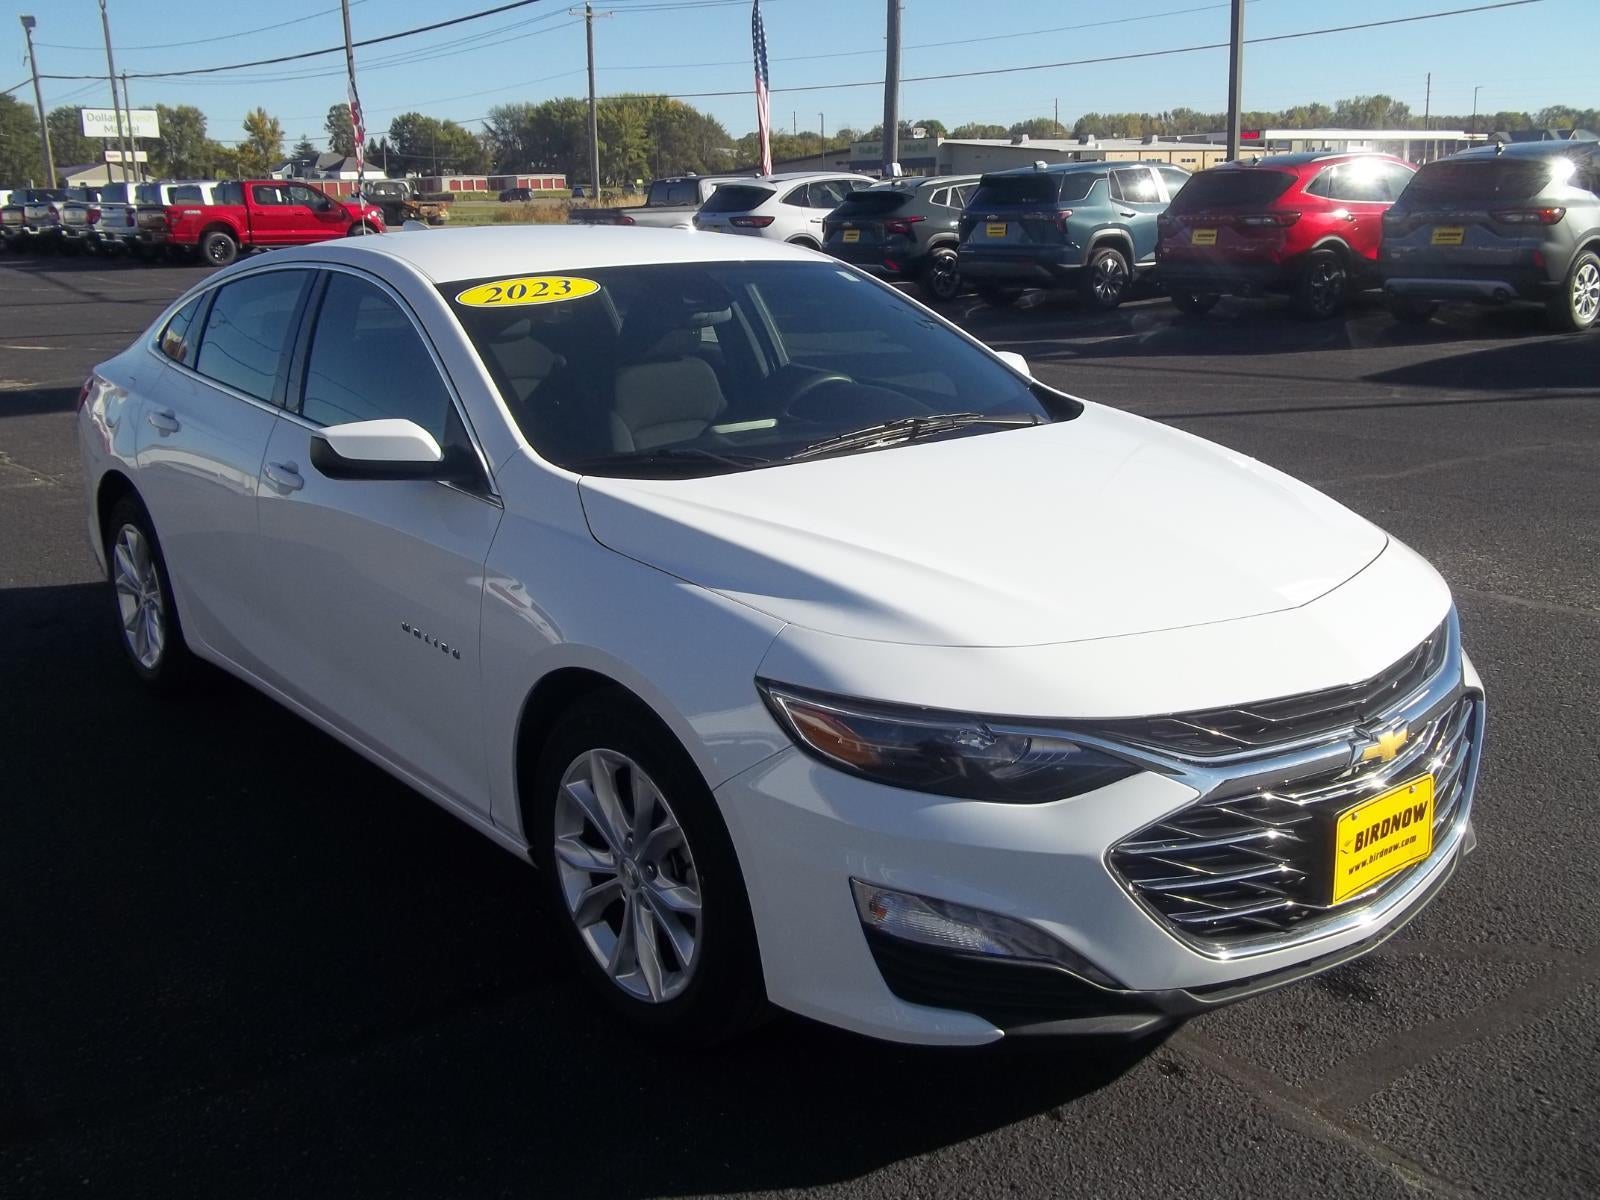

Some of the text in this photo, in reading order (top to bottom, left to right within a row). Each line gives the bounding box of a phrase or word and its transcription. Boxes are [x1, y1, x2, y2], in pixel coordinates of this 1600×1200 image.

[484, 279, 572, 304] 2023
[1354, 800, 1428, 853] BIRDNOW
[1348, 834, 1417, 876] www.birdnow.com
